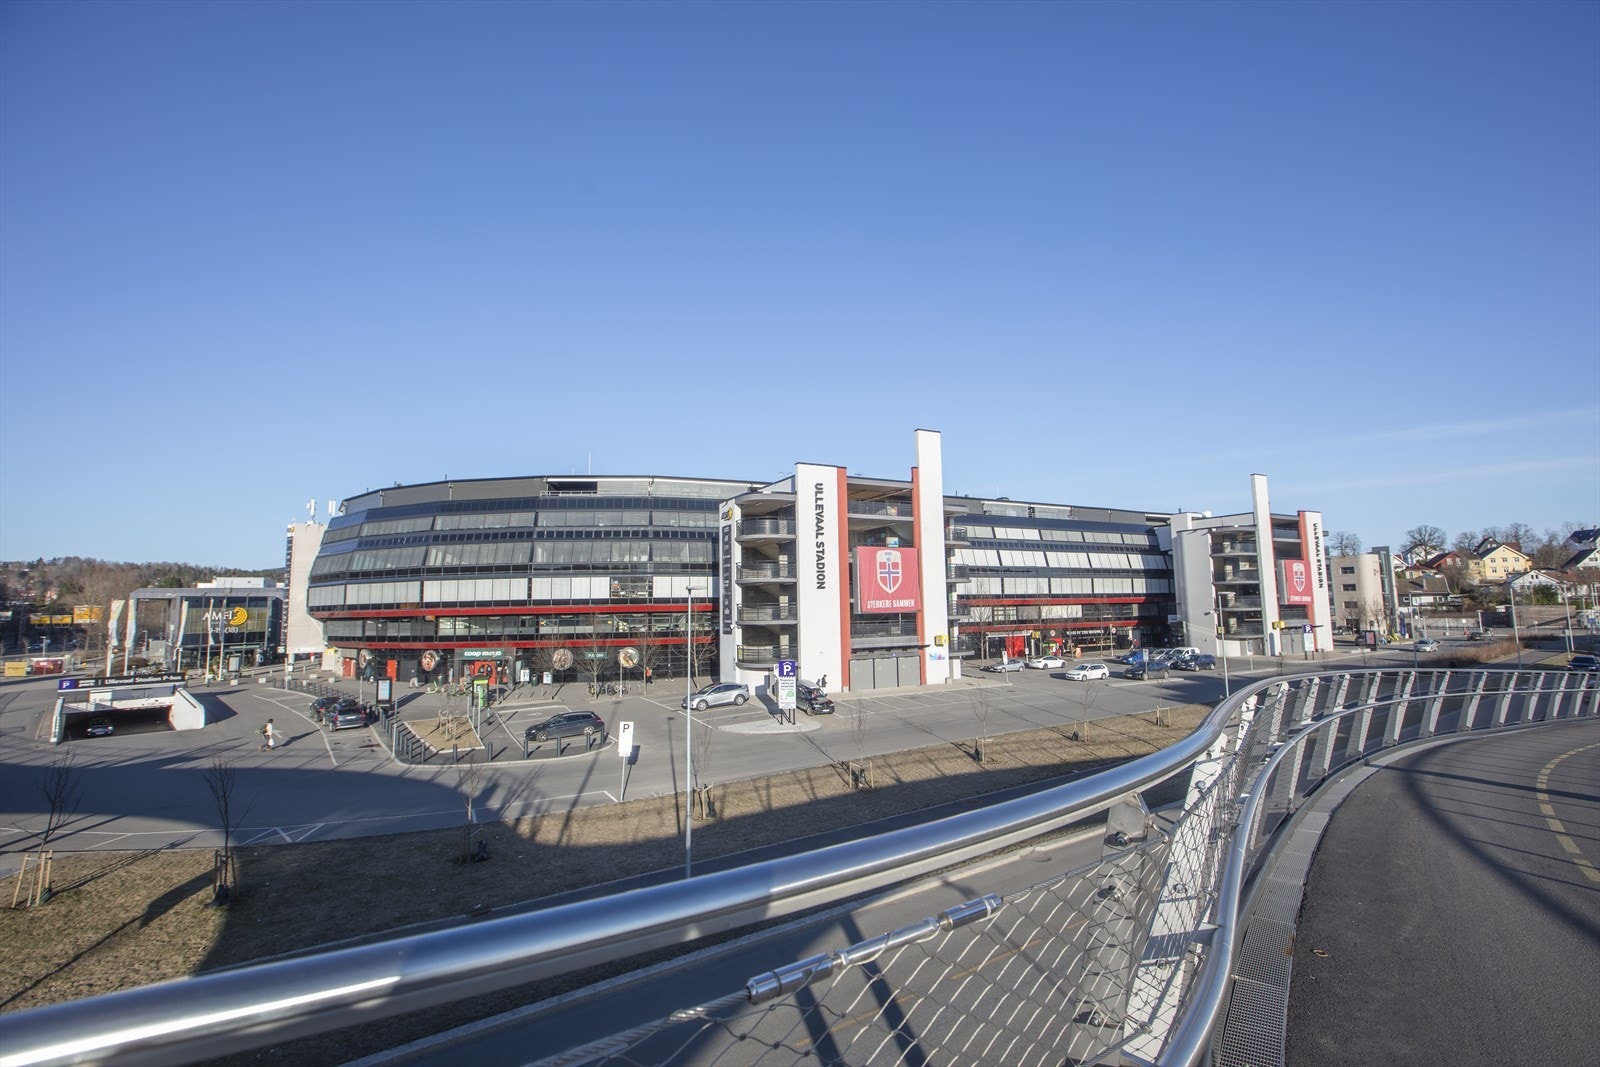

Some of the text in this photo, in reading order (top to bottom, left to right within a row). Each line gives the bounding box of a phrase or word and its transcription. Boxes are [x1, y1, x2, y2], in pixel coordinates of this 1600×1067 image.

[814, 482, 826, 589] ULLEVAAL STADION
[867, 599, 915, 609] STERKERE SAMMEN
[783, 664, 791, 676] P
[623, 723, 630, 733] P
